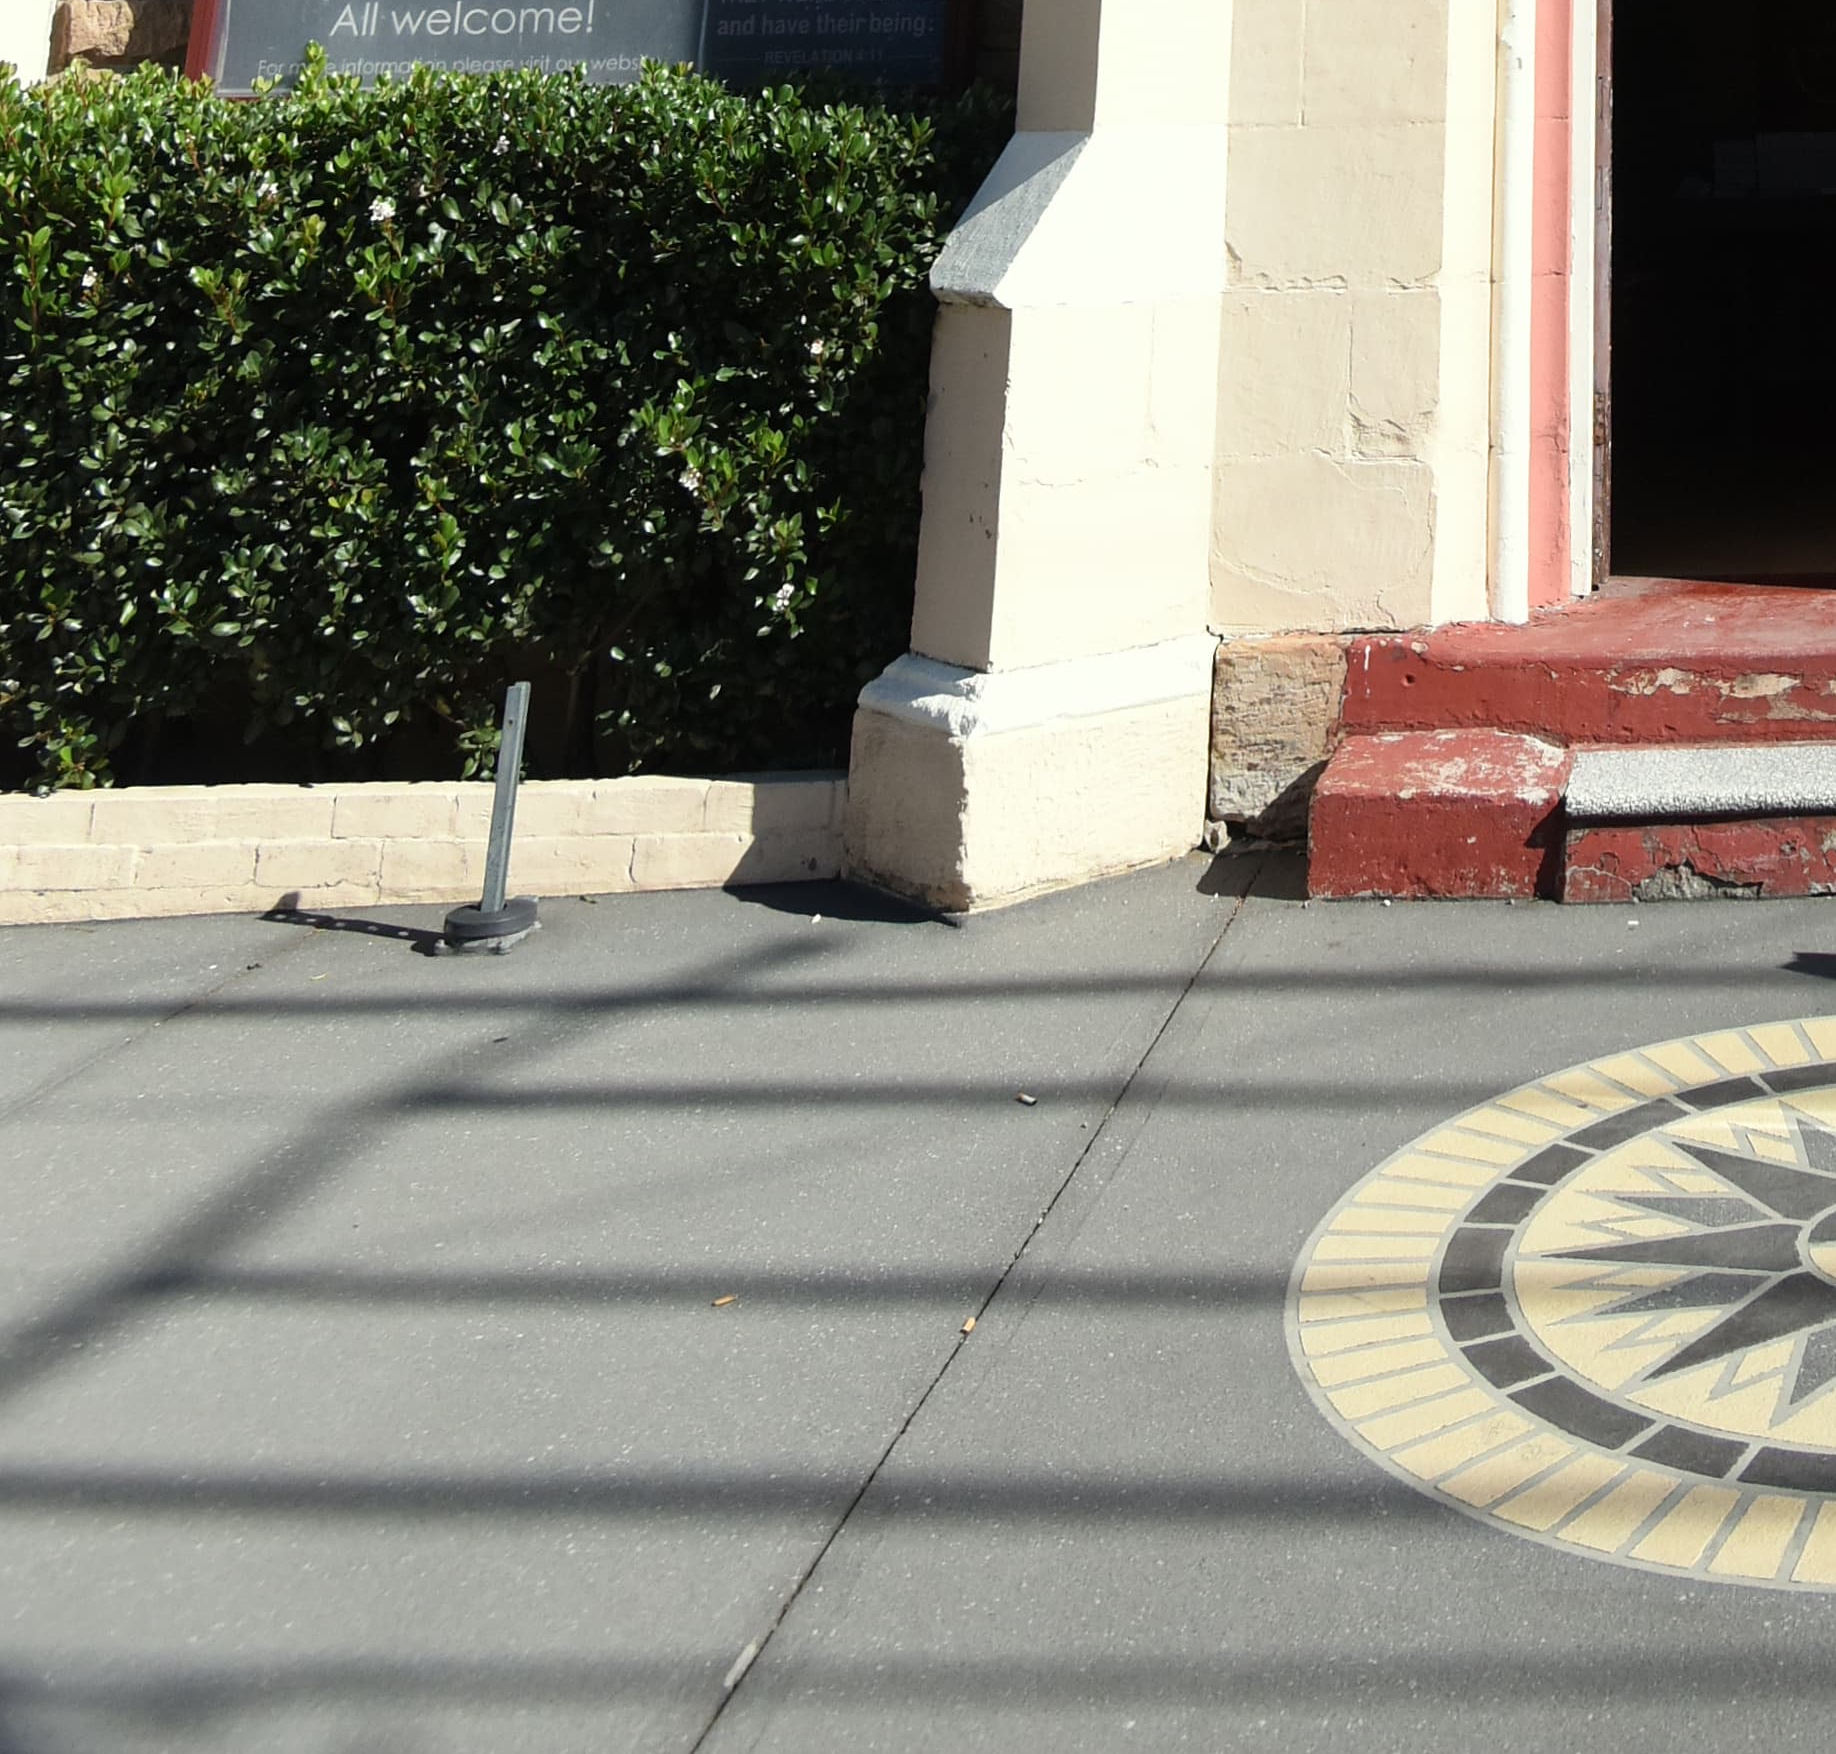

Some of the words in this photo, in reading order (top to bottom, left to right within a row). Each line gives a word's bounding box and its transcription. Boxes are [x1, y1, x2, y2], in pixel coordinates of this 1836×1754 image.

[329, 3, 379, 38] All
[391, 0, 595, 36] welcome!
[717, 14, 755, 36] and
[761, 13, 810, 35] have
[816, 12, 868, 33] their
[258, 59, 285, 74] For
